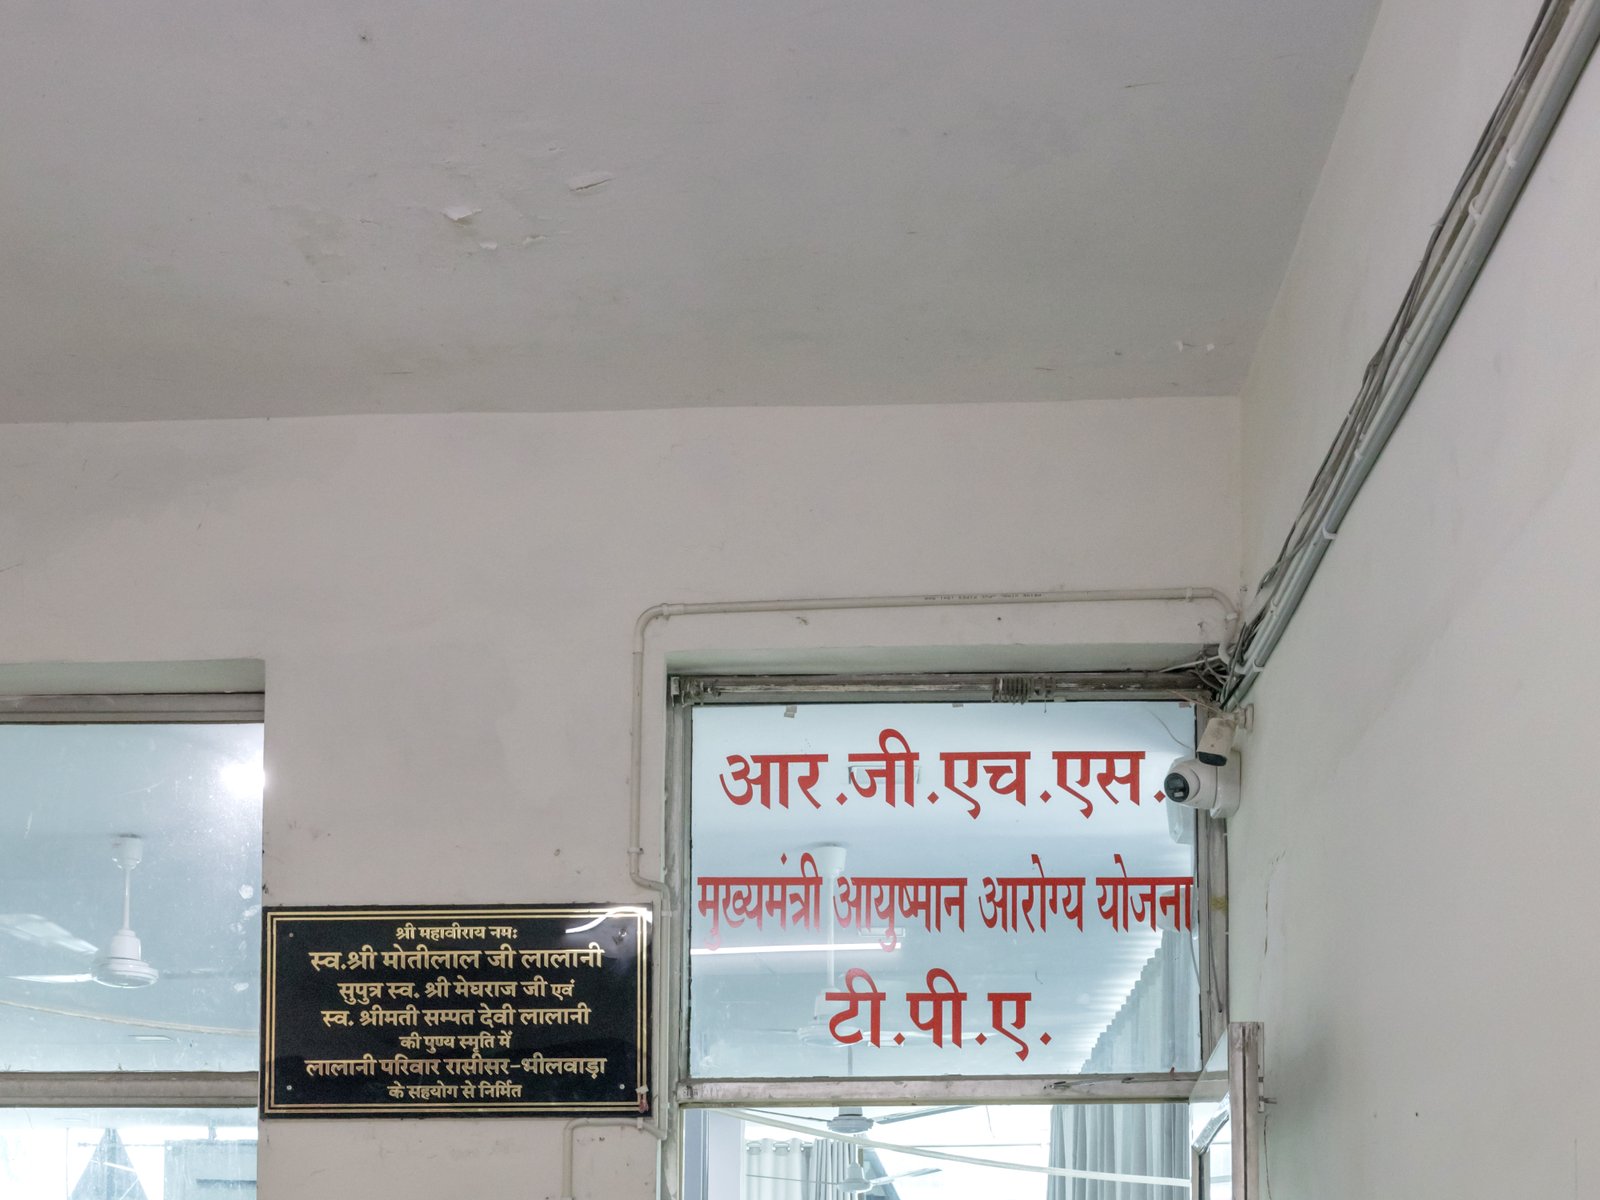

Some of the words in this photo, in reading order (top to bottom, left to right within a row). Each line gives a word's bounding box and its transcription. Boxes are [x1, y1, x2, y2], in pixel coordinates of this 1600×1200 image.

[697, 853, 823, 950] मुख्यमंत्री
[834, 876, 968, 953] आयुष्मान
[979, 854, 1087, 933] आरोग्य
[1096, 854, 1194, 933] योजना
[396, 922, 415, 940] श्री
[419, 922, 486, 942] महावीराय
[381, 944, 482, 970] मोतीलाल
[485, 944, 515, 970] जी
[519, 942, 605, 969] लालानी
[337, 982, 384, 1004] सुपुत्र
[386, 982, 420, 999] स्व.
[424, 976, 451, 998] श्री
[453, 975, 518, 998] मेघराज
[521, 975, 548, 998] जी
[550, 979, 575, 1000] एवं
[321, 1009, 355, 1028] स्व.
[360, 1004, 420, 1027] श्रीमती
[423, 1009, 476, 1026] सम्पत
[479, 1004, 517, 1028] देवी
[519, 1002, 593, 1025] लालानी
[825, 967, 1052, 1062] टी.पी.ए.
[399, 1032, 422, 1050] की
[424, 1036, 456, 1053] पुण्य
[459, 1030, 497, 1053] स्मृति
[499, 1030, 513, 1049] में
[304, 1054, 377, 1077] लालानी
[379, 1054, 441, 1077] परिवार
[387, 1080, 405, 1098] के
[407, 1080, 459, 1100] सहयोग
[461, 1080, 476, 1098] से
[479, 1080, 523, 1098] निर्मित
